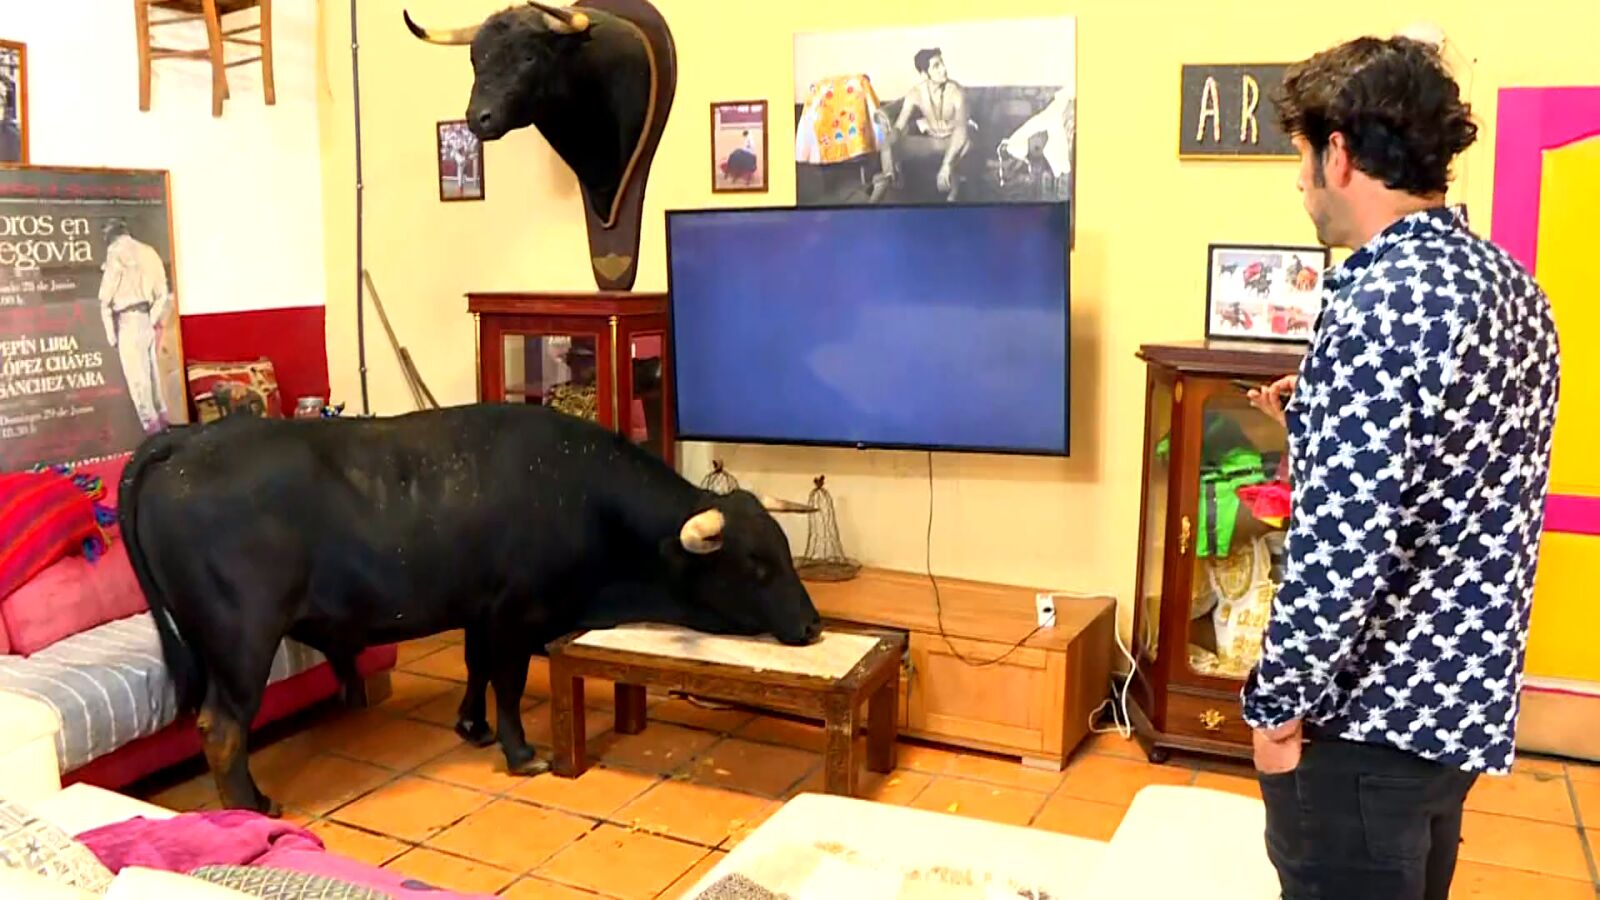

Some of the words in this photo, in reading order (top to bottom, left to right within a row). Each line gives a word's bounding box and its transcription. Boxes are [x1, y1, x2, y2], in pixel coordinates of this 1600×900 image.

[61, 217, 90, 235] en
[0, 236, 93, 271] egovia
[66, 371, 105, 389] VARA
